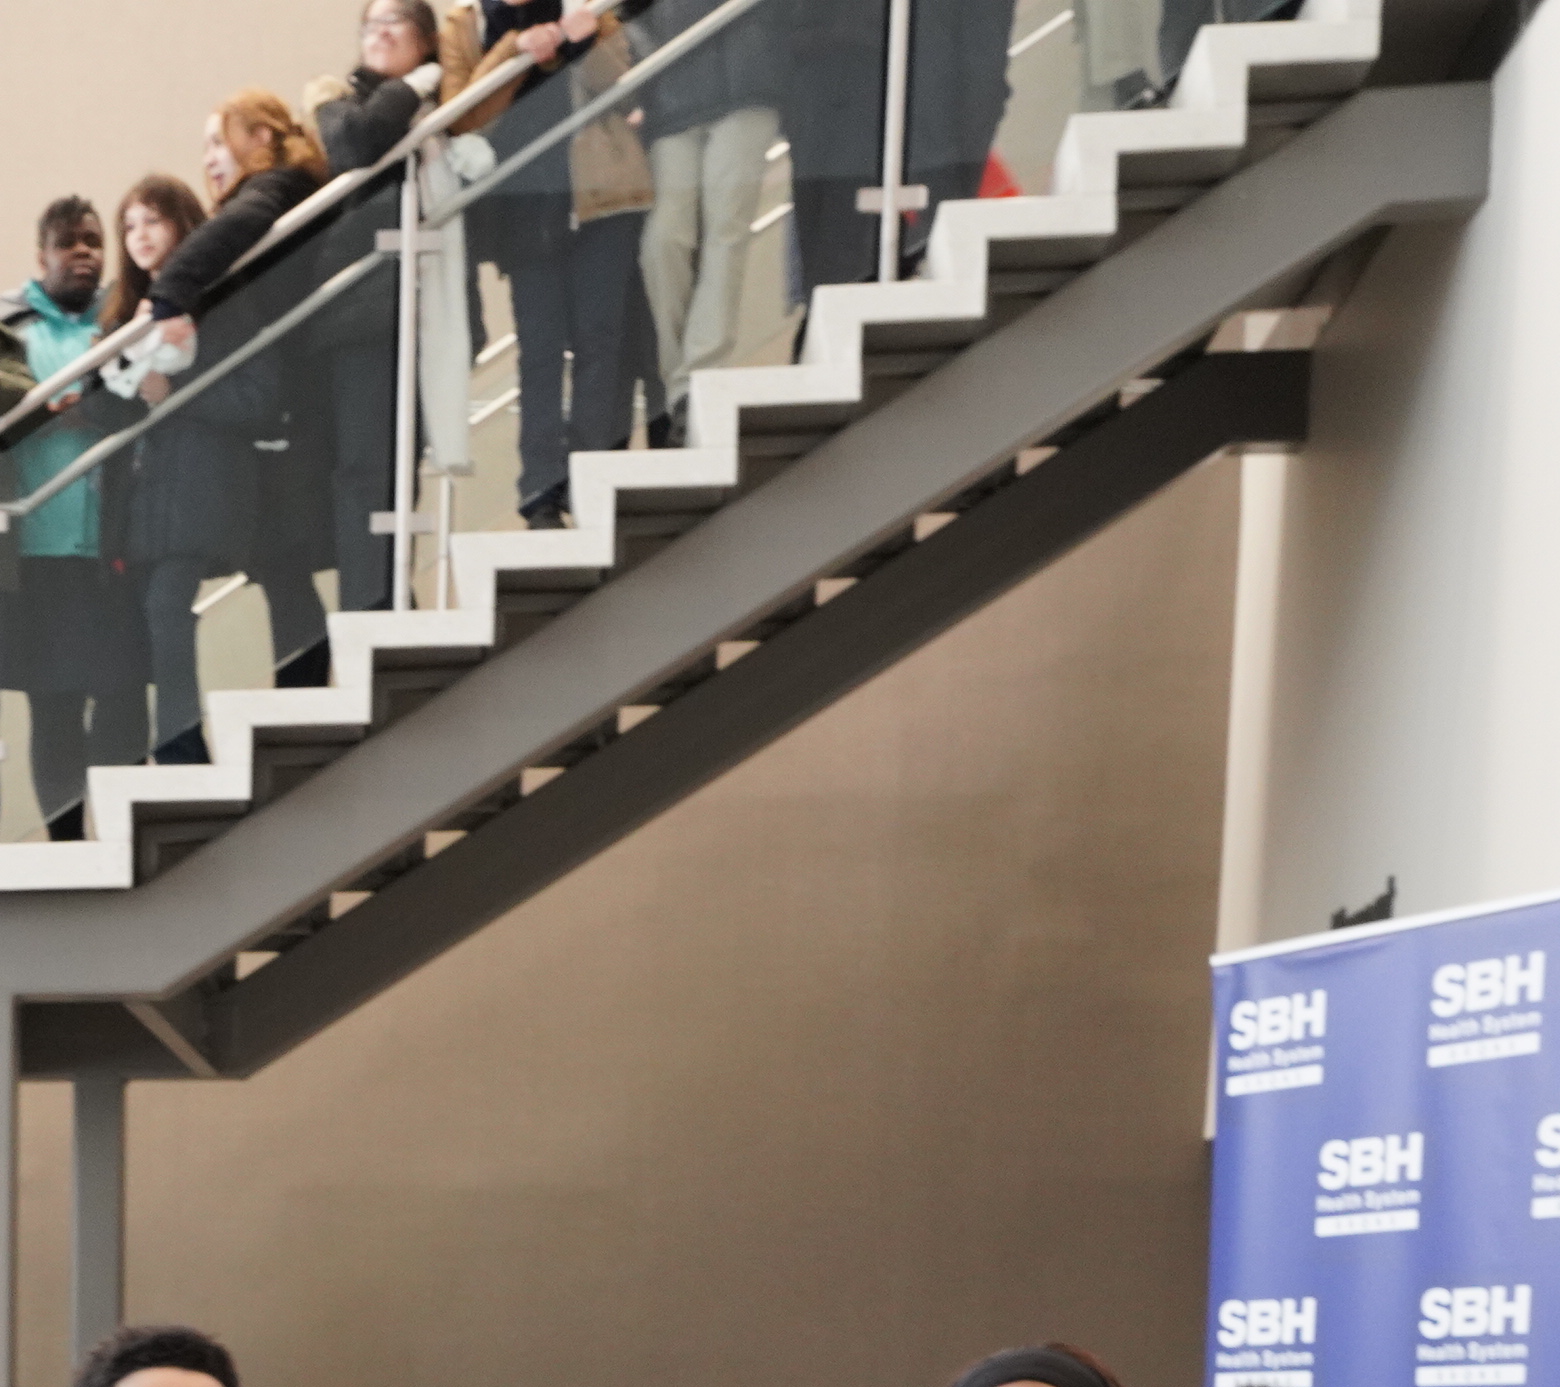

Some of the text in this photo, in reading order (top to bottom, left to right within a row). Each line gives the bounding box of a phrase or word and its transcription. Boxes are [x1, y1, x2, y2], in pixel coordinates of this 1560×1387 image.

[1430, 950, 1546, 1018] SBH
[1227, 988, 1328, 1050] SBH
[1317, 1132, 1424, 1190] SBH
[1216, 1296, 1318, 1348] SBH
[1418, 1284, 1532, 1340] SBH
